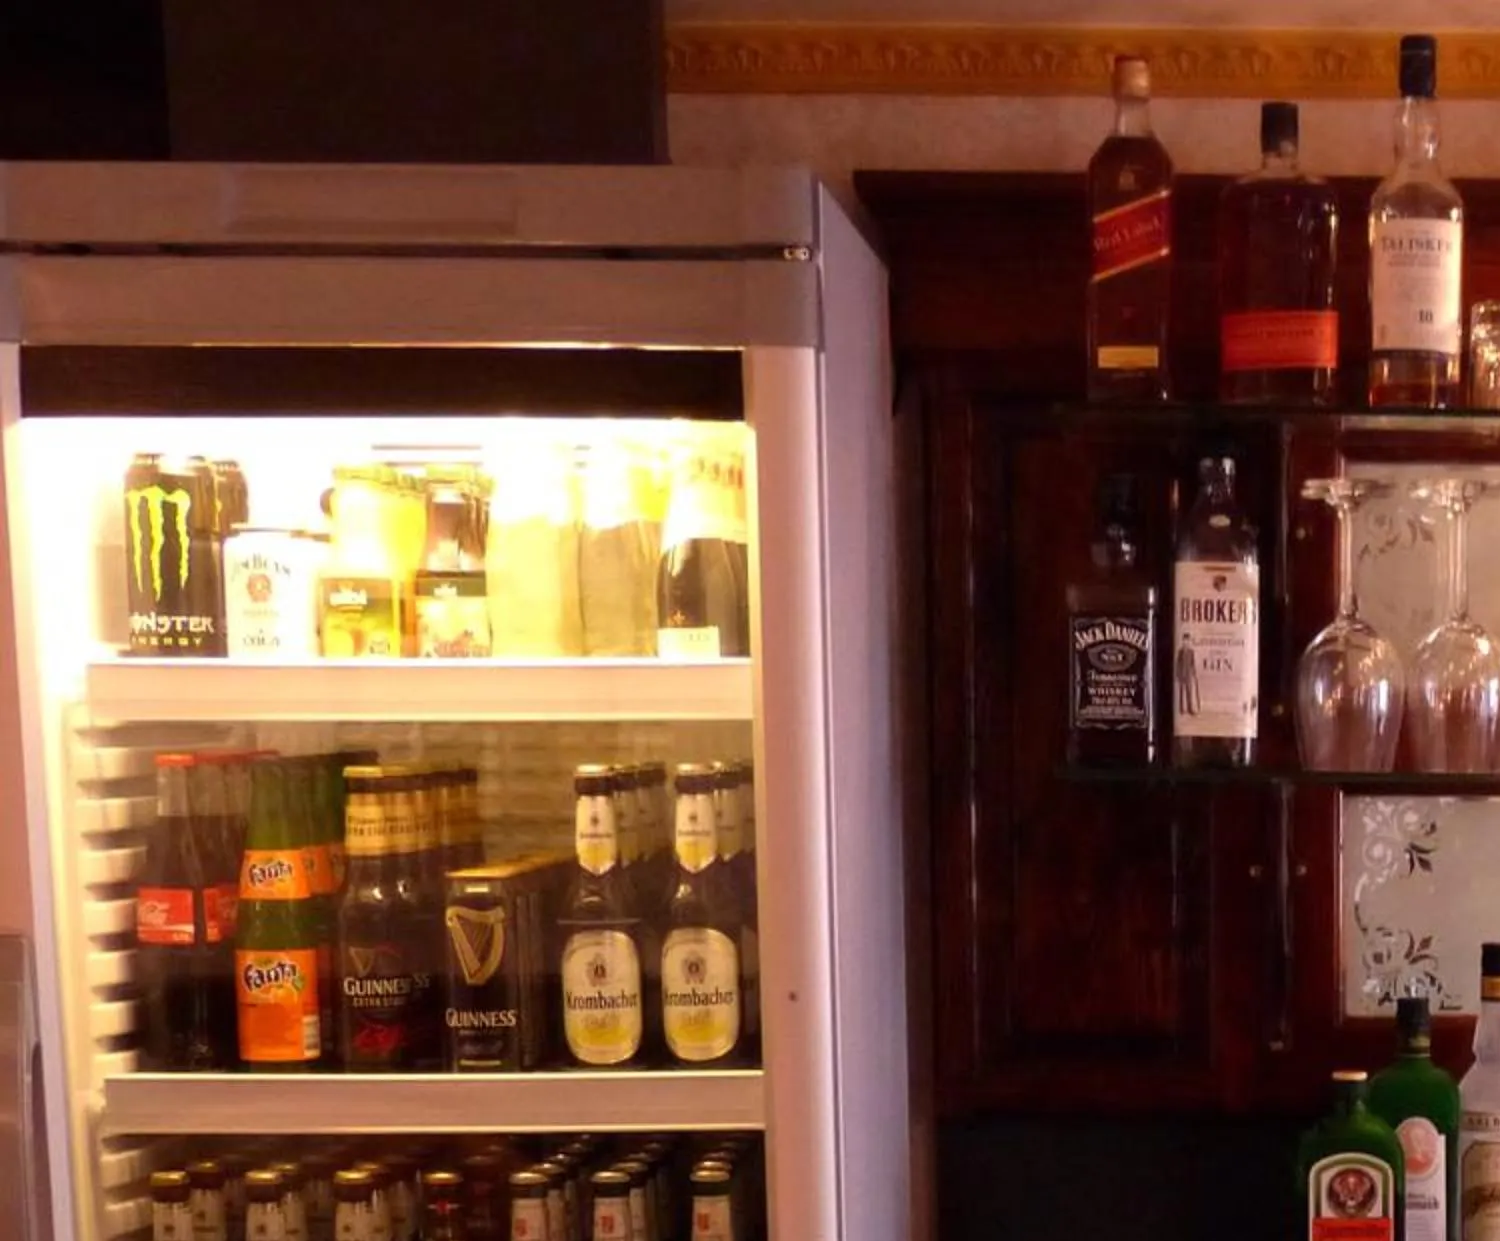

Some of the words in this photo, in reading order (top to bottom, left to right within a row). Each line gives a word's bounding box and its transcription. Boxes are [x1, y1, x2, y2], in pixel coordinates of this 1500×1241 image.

[1180, 598, 1257, 625] BROKERS
[1075, 626, 1104, 650] JACK
[446, 1007, 517, 1028] GUINNESS
